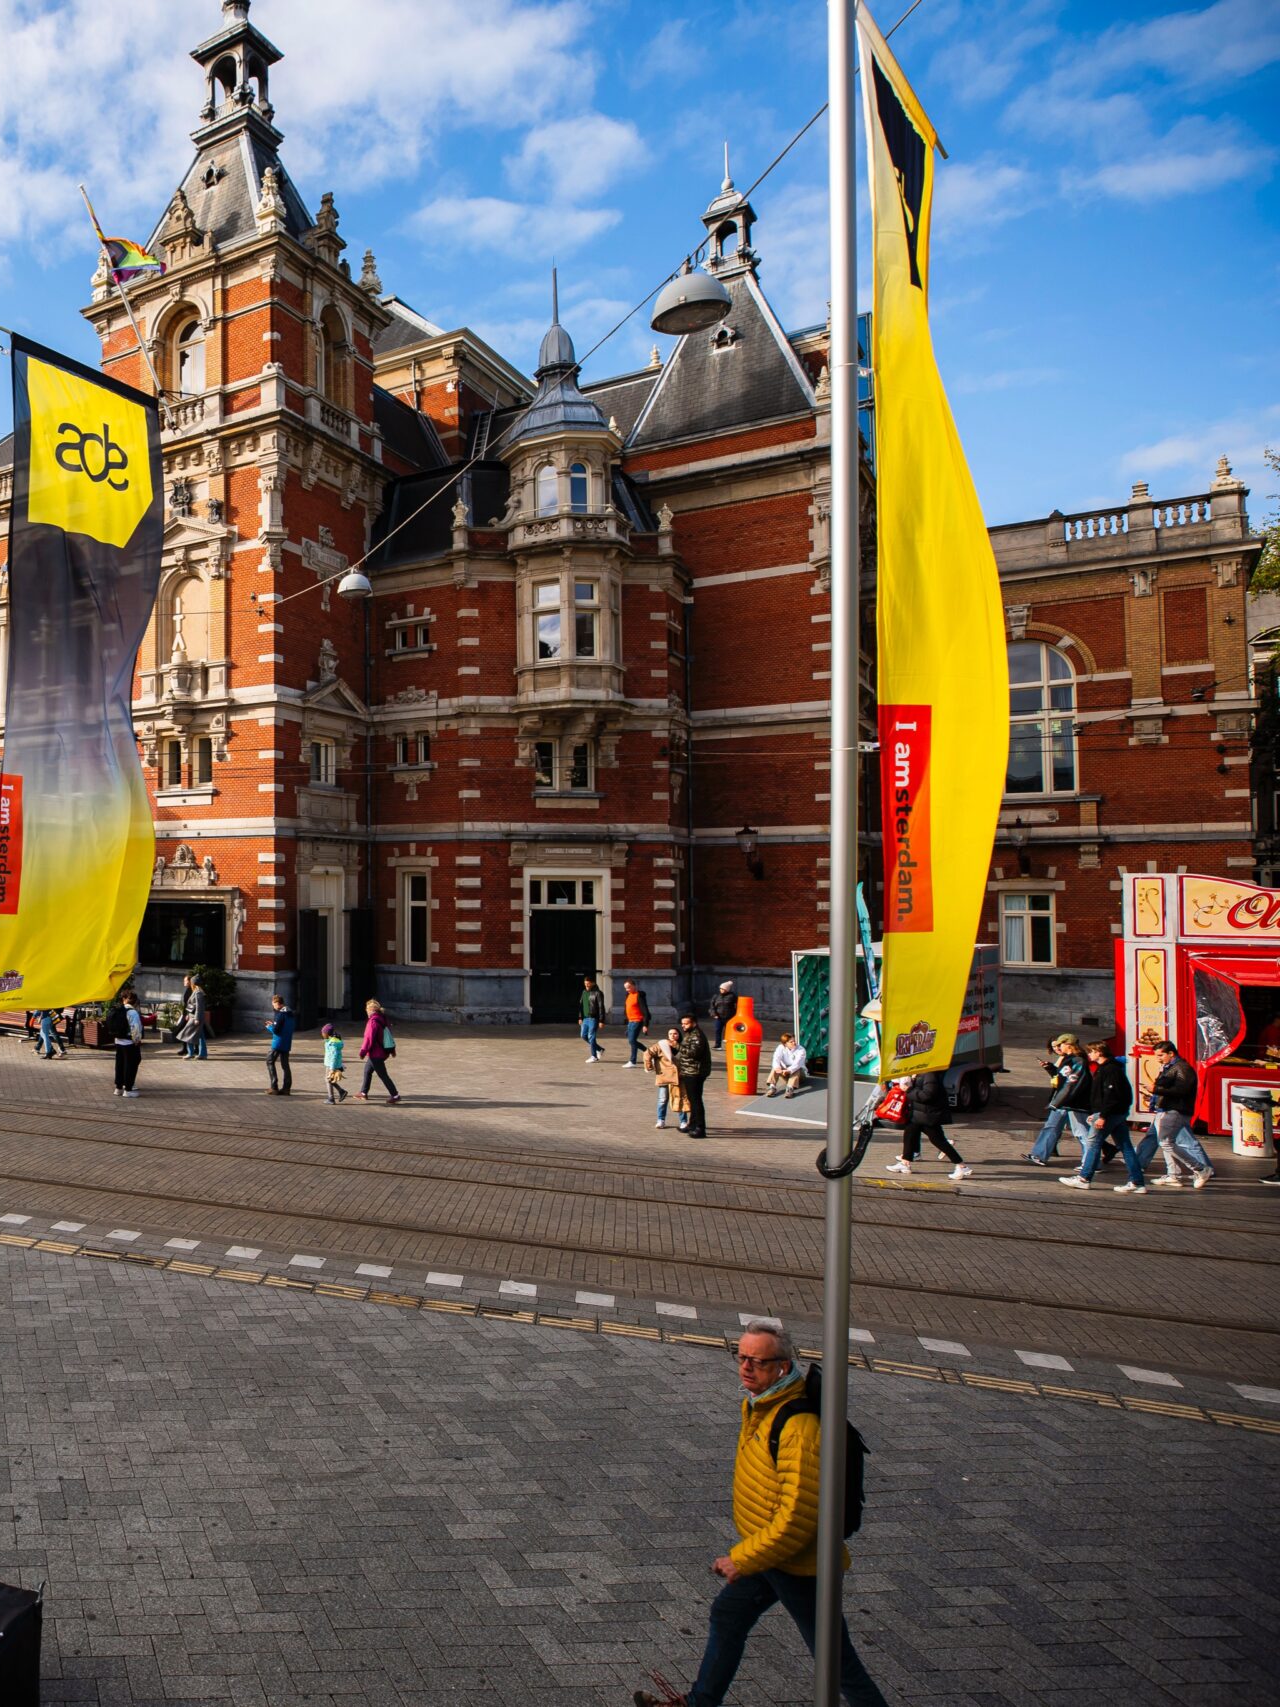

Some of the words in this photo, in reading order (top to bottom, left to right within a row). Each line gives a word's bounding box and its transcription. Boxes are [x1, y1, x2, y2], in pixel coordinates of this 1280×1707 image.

[55, 422, 129, 491] ade
[895, 721, 917, 731] I
[894, 742, 918, 922] amsterdam.
